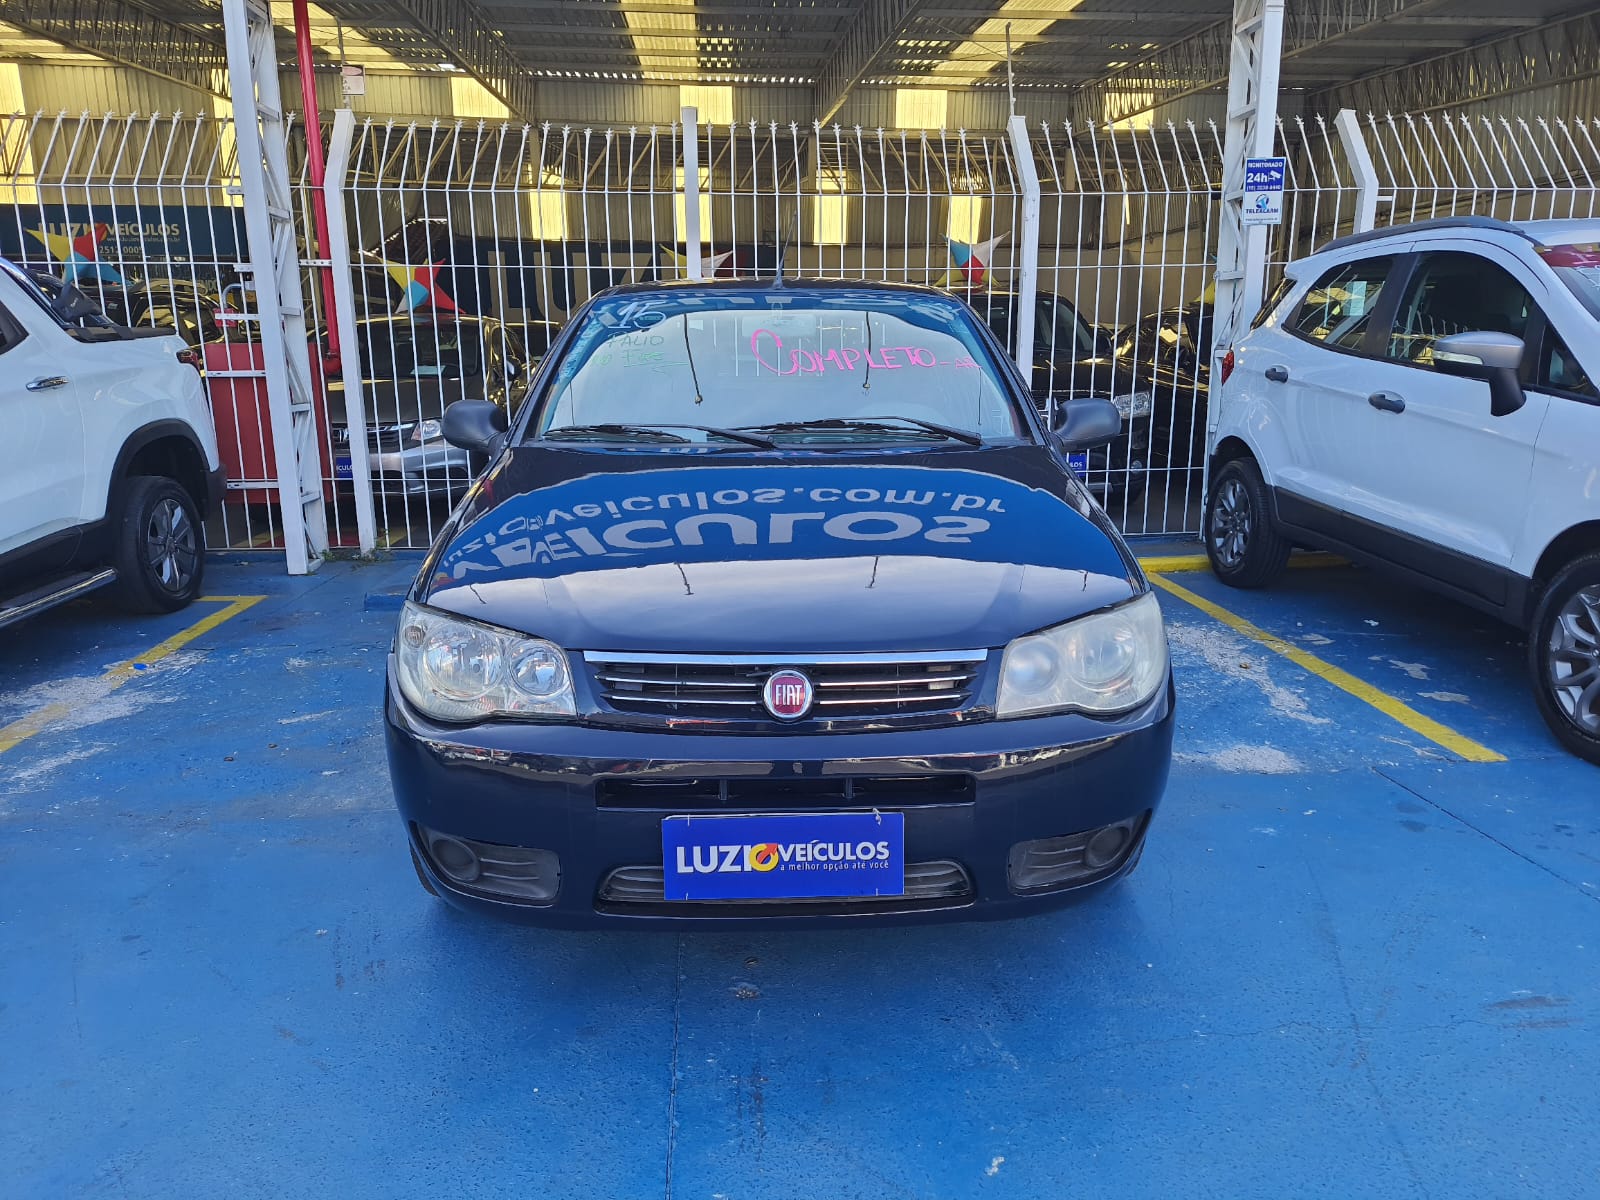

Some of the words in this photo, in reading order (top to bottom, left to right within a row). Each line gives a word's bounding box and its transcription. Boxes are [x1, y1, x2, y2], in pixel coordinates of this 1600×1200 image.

[1246, 172, 1268, 183] 24h
[751, 329, 936, 375] COMPLETO
[775, 684, 802, 706] FIAT
[676, 843, 779, 873] LUZIO
[778, 839, 890, 862] VEÍCULOS
[789, 862, 820, 871] melhor
[823, 861, 849, 872] opção
[852, 860, 866, 870] até
[869, 860, 889, 869] você
